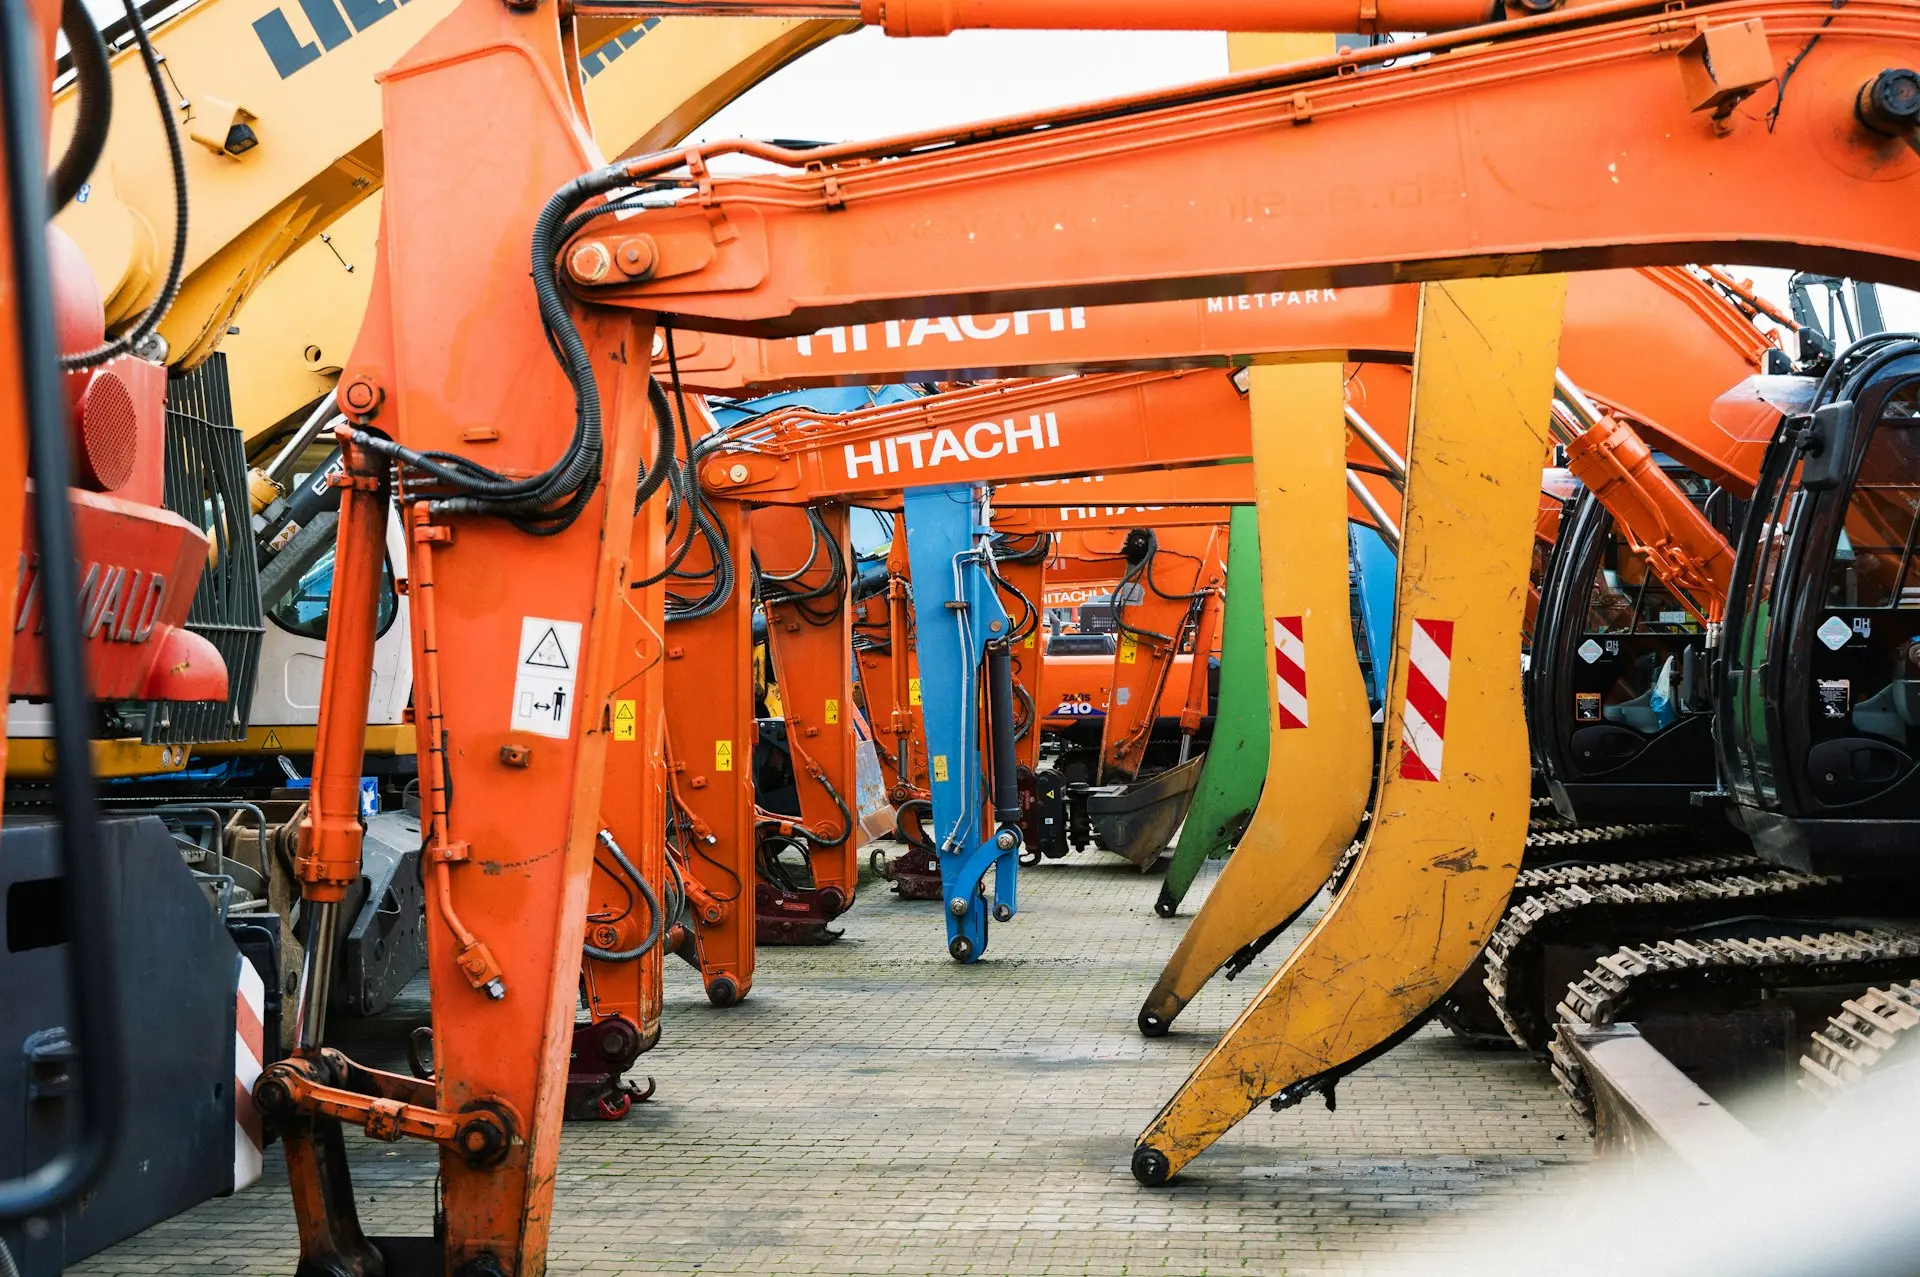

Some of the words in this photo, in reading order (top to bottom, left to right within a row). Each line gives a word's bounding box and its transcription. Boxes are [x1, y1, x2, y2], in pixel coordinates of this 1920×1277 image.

[1207, 288, 1337, 313] MIETPARK
[843, 412, 1060, 479] HITACHI
[1062, 693, 1091, 702] ZAXIS
[1057, 702, 1092, 714] 210
